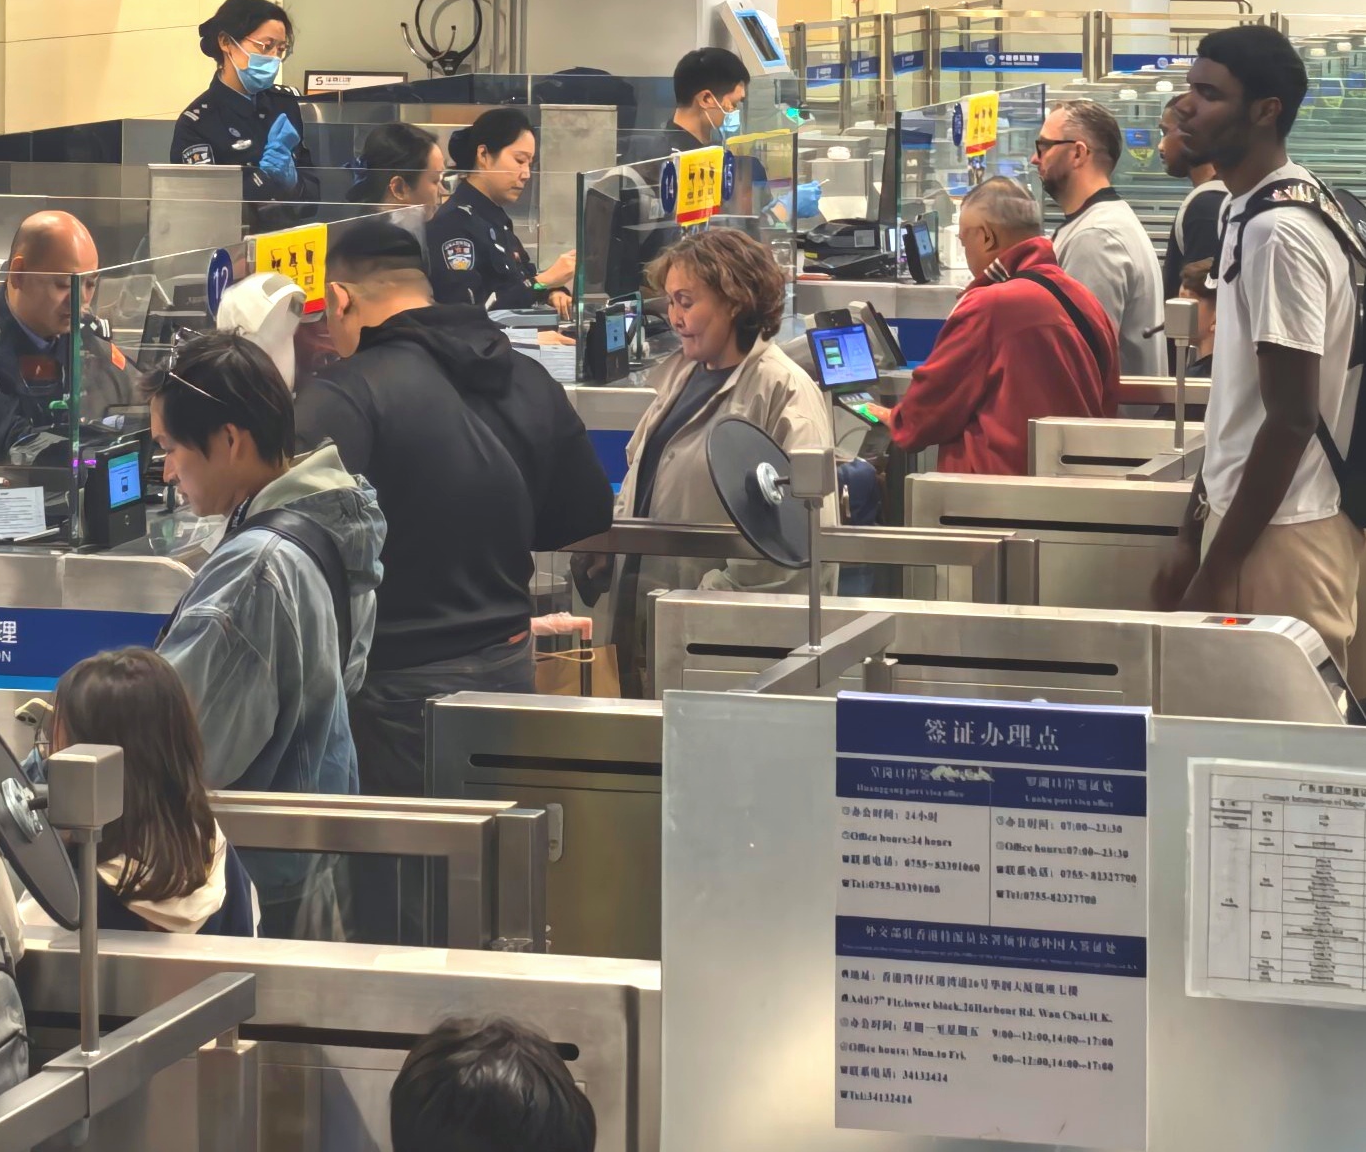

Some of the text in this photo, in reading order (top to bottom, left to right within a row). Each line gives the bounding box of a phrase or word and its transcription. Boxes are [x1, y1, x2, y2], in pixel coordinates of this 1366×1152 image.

[923, 718, 1060, 751] 签证办理点
[1038, 1008, 1061, 1019] Wan
